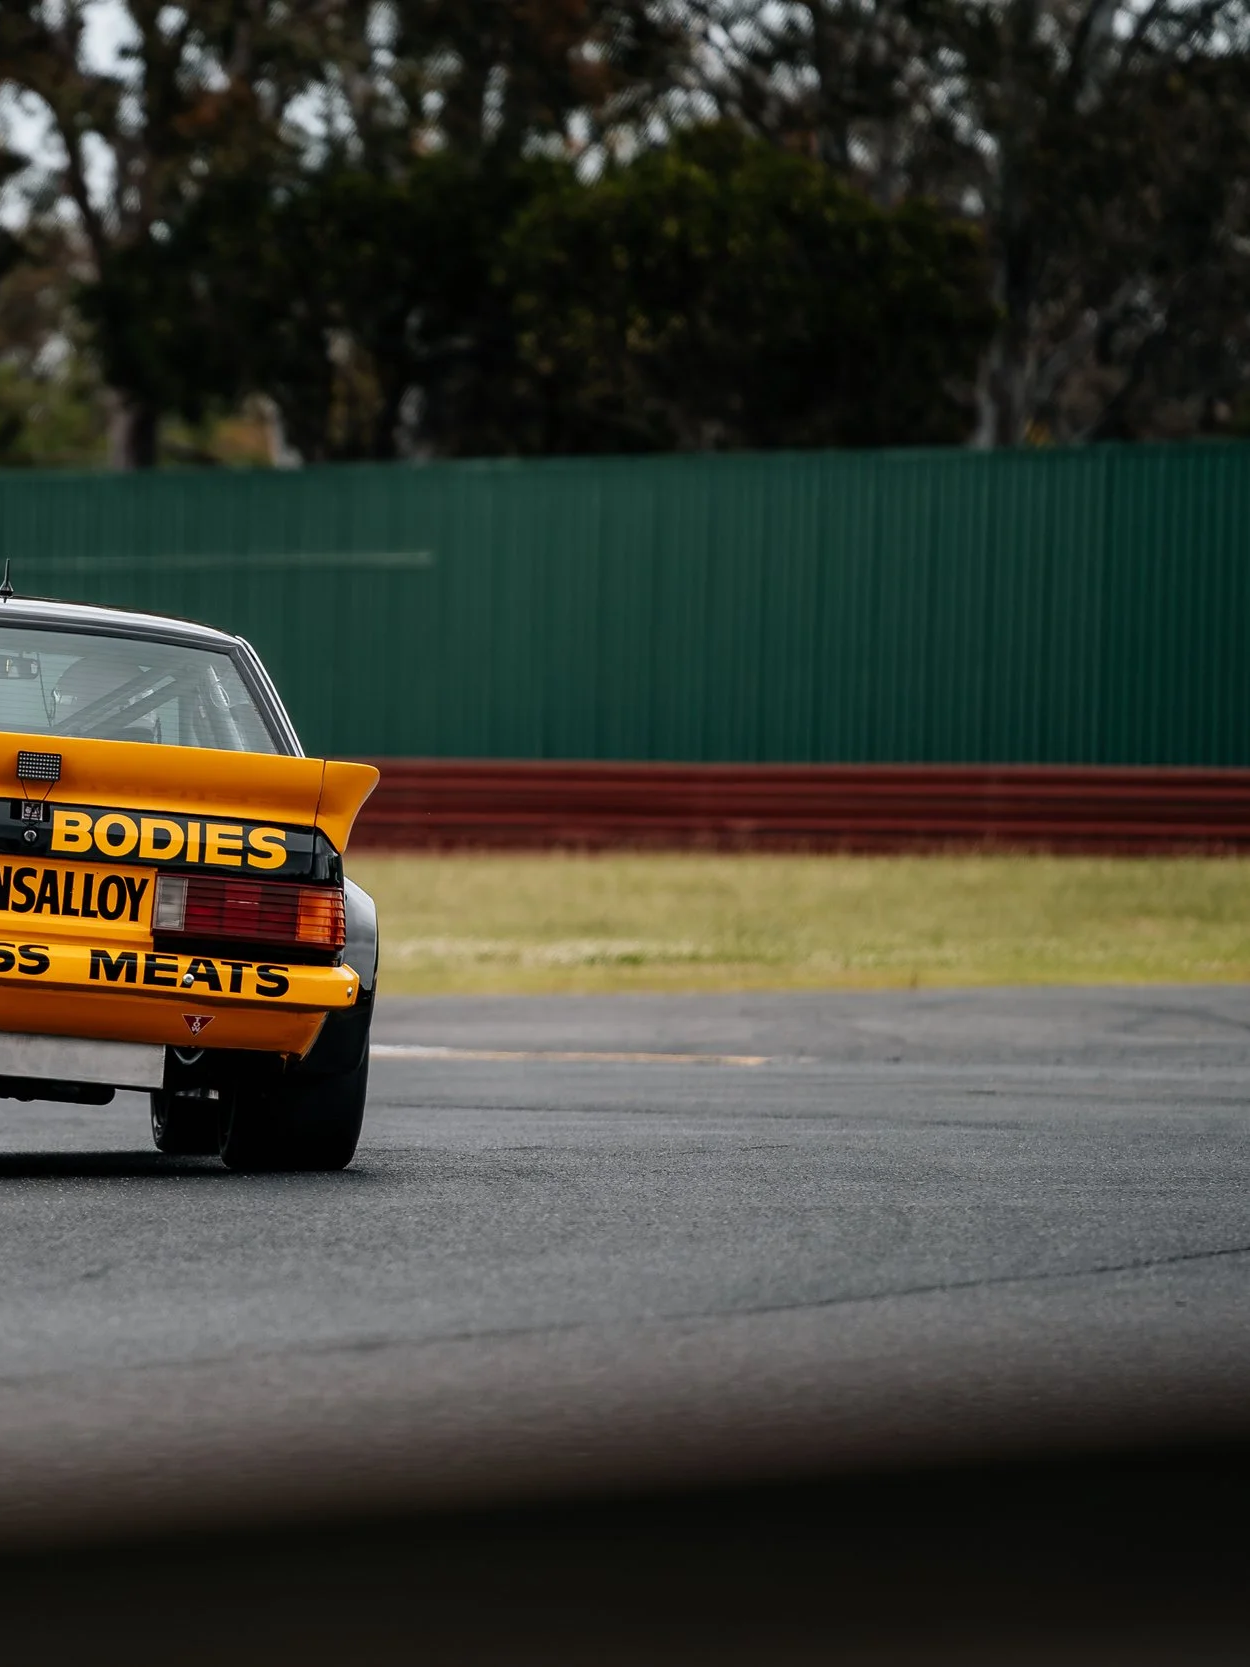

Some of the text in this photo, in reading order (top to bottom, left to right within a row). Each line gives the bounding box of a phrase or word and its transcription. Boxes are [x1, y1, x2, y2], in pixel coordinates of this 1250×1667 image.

[51, 810, 287, 869] BODIES
[89, 949, 290, 998] MEATS
[191, 1016, 202, 1032] TOW
